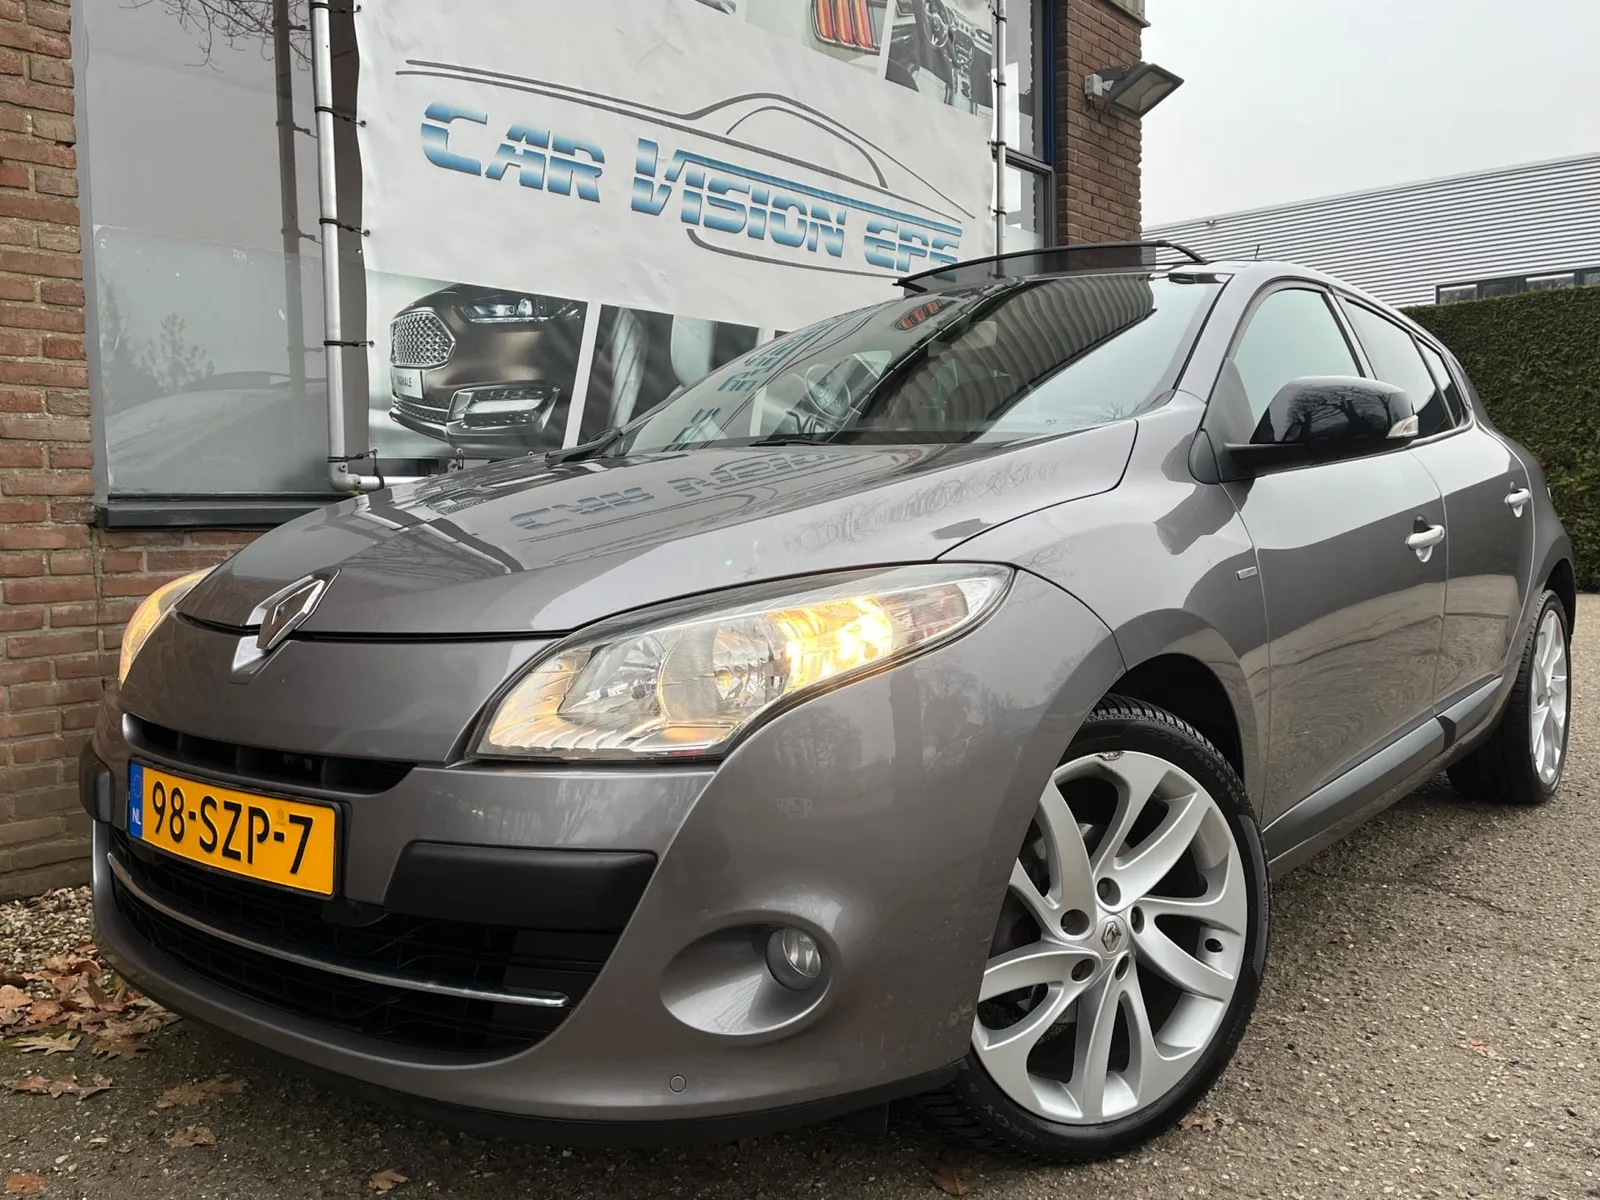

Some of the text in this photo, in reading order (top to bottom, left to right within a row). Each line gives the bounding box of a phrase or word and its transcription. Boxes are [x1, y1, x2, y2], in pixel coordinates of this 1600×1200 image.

[421, 101, 606, 203] CAR
[631, 137, 847, 258] VISION
[131, 806, 142, 826] NL
[152, 780, 314, 876] 98-SZP-7
